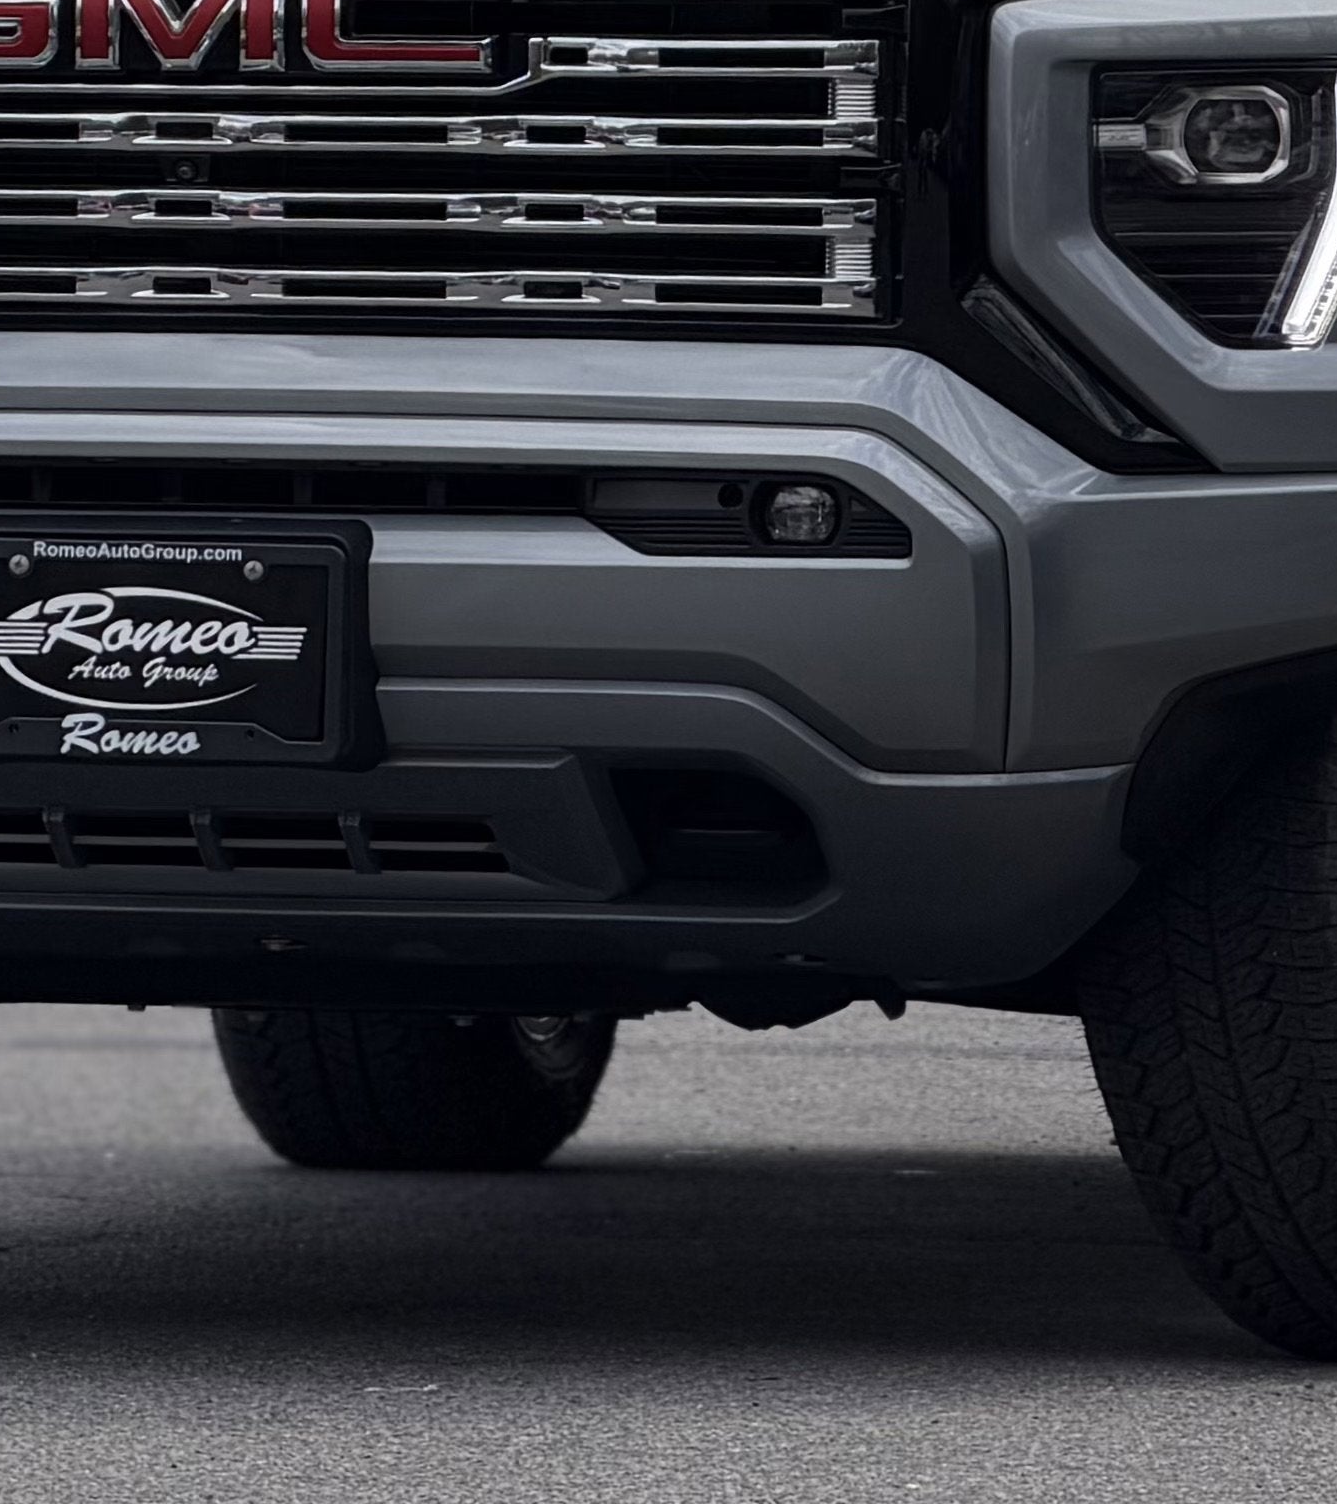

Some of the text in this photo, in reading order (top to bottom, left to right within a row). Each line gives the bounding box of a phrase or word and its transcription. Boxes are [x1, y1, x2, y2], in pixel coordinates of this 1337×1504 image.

[33, 541, 243, 563] RomeoAutoGroup.com
[40, 592, 257, 655] Romeo
[68, 657, 220, 688] Auto Group
[60, 712, 201, 755] Romeo
